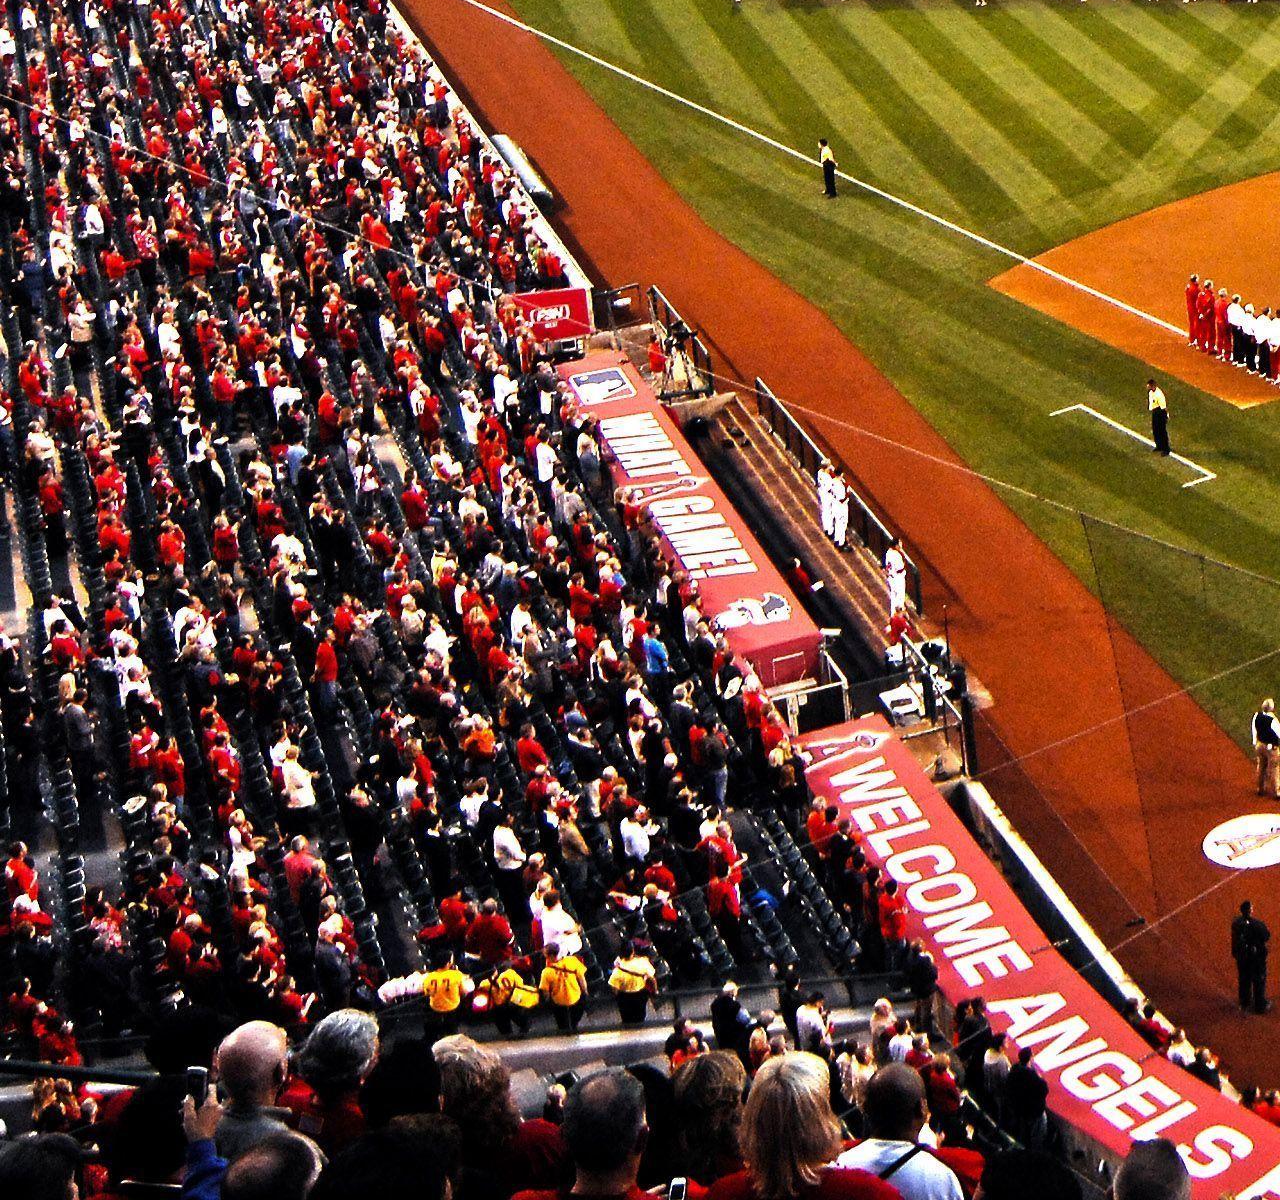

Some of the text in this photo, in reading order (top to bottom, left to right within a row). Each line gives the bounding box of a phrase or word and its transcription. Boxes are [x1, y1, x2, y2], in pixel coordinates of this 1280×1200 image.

[599, 411, 695, 479] WHAT
[648, 496, 760, 580] GAME!
[829, 756, 1034, 987] WELCOME
[986, 991, 1253, 1180] ANGELS
